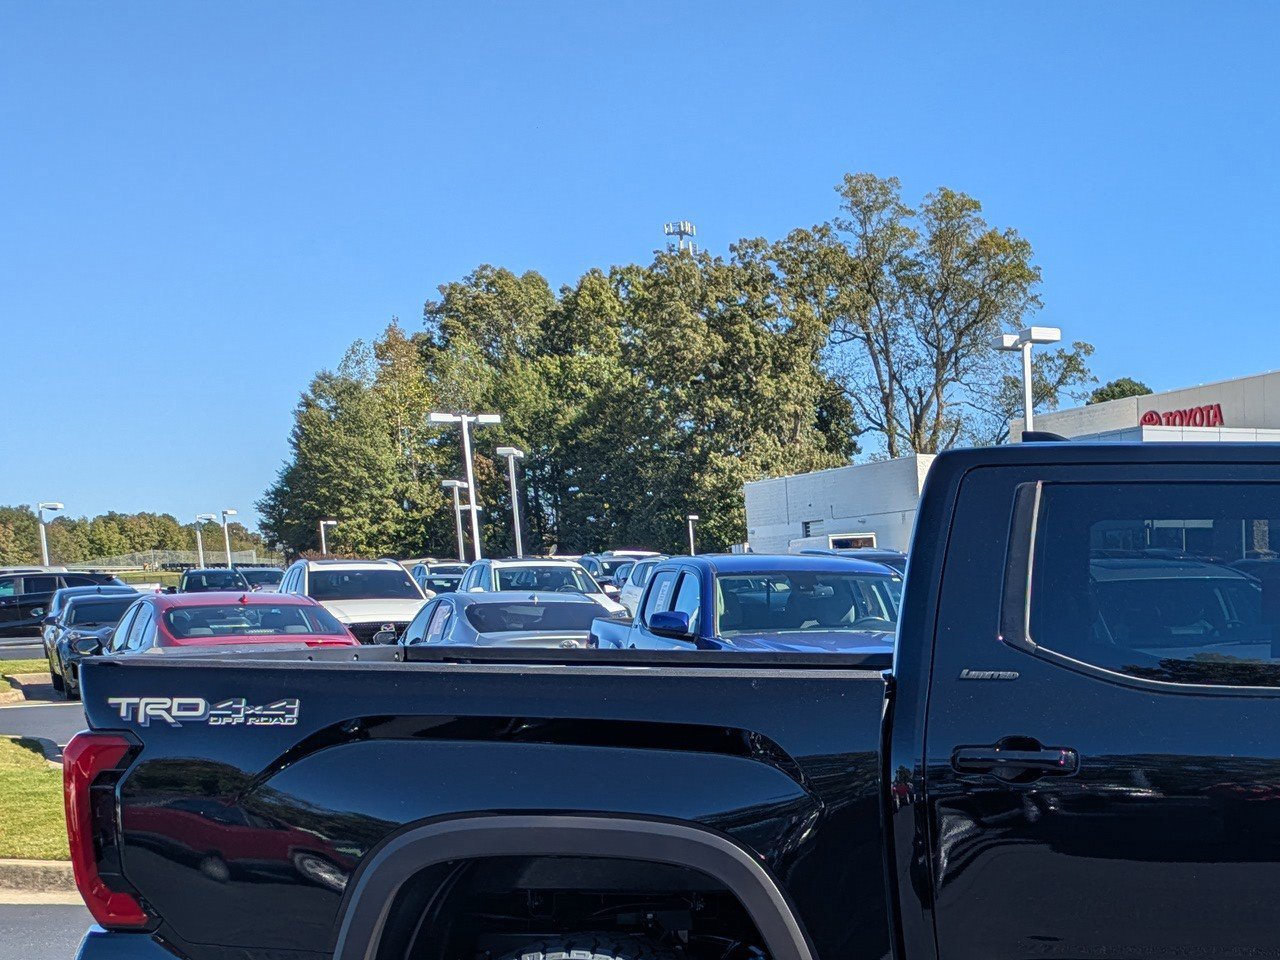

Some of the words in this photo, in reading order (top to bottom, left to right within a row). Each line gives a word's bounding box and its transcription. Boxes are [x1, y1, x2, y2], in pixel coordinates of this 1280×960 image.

[1162, 403, 1225, 427] TOYOTA
[108, 697, 210, 727] TRD
[209, 716, 243, 726] OFF
[246, 716, 298, 726] ROAD
